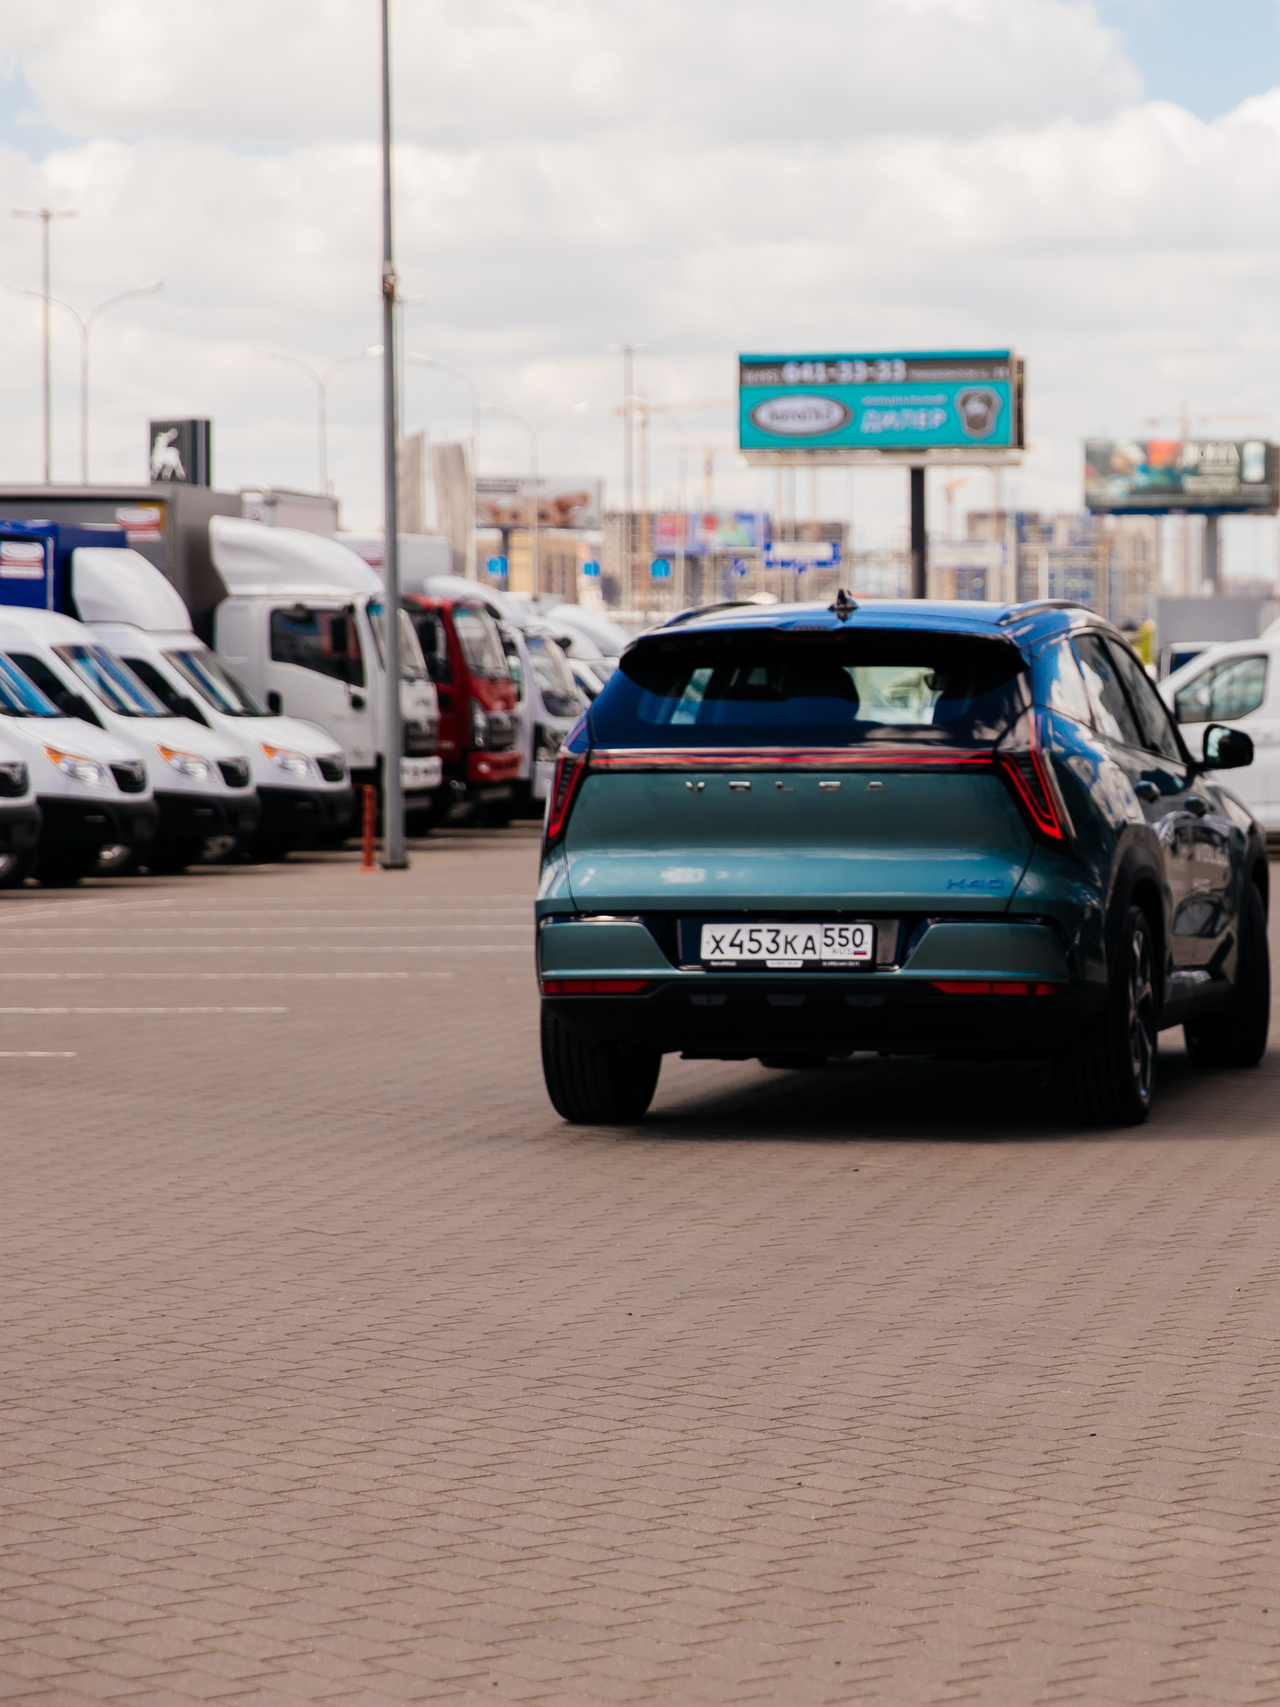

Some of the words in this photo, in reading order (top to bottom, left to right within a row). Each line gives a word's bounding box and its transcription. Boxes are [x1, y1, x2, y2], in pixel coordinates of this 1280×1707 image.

[782, 360, 907, 384] 641-33-33
[945, 877, 1005, 890] K40
[710, 928, 817, 955] Х453КА
[823, 927, 865, 948] 550
